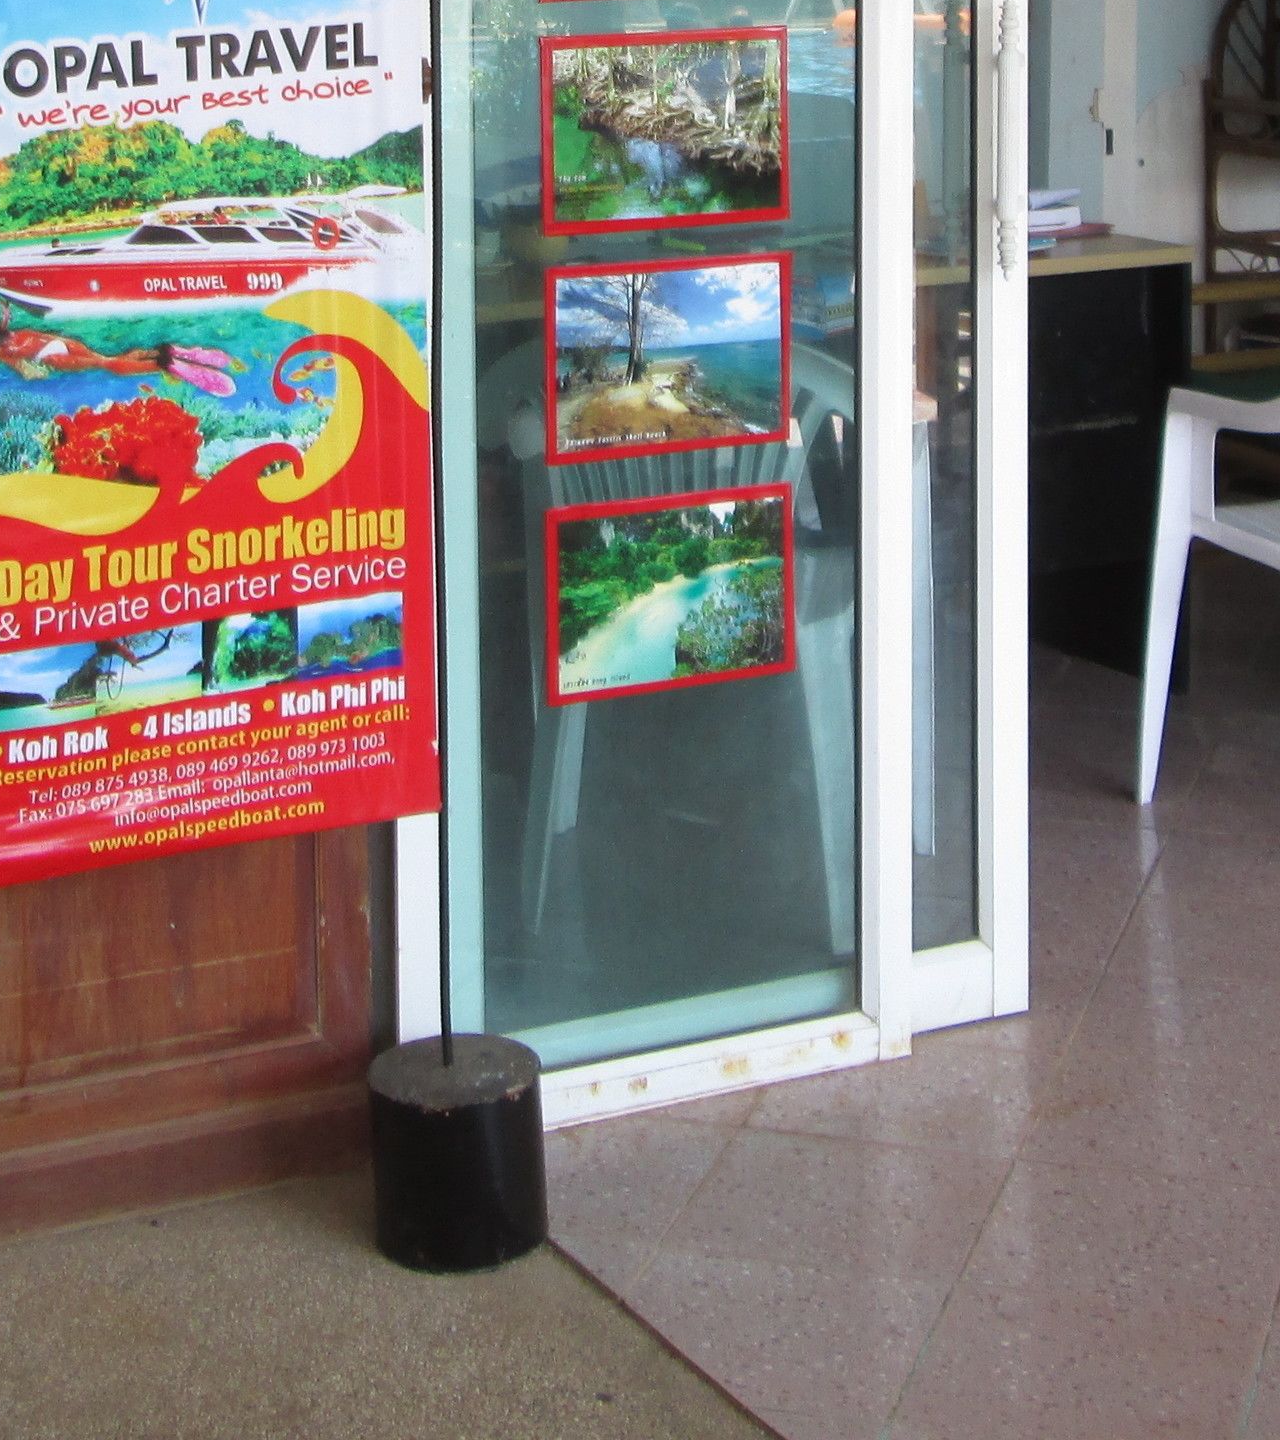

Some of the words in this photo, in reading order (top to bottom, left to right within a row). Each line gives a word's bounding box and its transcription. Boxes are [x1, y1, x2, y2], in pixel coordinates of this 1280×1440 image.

[2, 39, 158, 98] OPAL
[175, 22, 379, 81] TRAVEL
[119, 93, 190, 123] your
[143, 276, 174, 293] OPAL
[178, 274, 227, 290] TRAVEL
[246, 272, 283, 291] 999
[82, 541, 178, 592] Tour
[186, 507, 405, 574] Snorkeling
[35, 595, 149, 636] Private
[160, 571, 282, 614] Charter
[291, 555, 407, 593] Service
[8, 735, 58, 764] Koh
[63, 726, 109, 757] Rok
[143, 714, 158, 740] 4
[163, 701, 252, 737] Islands
[281, 689, 326, 717] Koh
[331, 681, 367, 710] Phi
[371, 675, 406, 704] Phi
[112, 743, 172, 771] please
[176, 730, 246, 756] contact
[251, 724, 292, 747] your
[296, 713, 348, 739] agent
[352, 712, 372, 728] or
[374, 703, 411, 723] call:
[18, 806, 53, 825] Fax:
[56, 799, 87, 818] 075
[90, 794, 120, 811] 697
[124, 788, 154, 807] 283
[157, 777, 206, 801] Email:
[29, 787, 58, 805] Tel:
[61, 781, 91, 800] 089
[95, 776, 124, 794] 875
[128, 767, 172, 786] 4938,
[175, 761, 206, 779] 089
[209, 755, 238, 773] 469
[242, 748, 284, 767] 9262,
[287, 743, 317, 761] 089
[320, 737, 347, 755] 973
[351, 731, 386, 750] 1003
[89, 799, 326, 853] www.opalspeedboat.com
[114, 780, 313, 827] info@opalspeedboat.com
